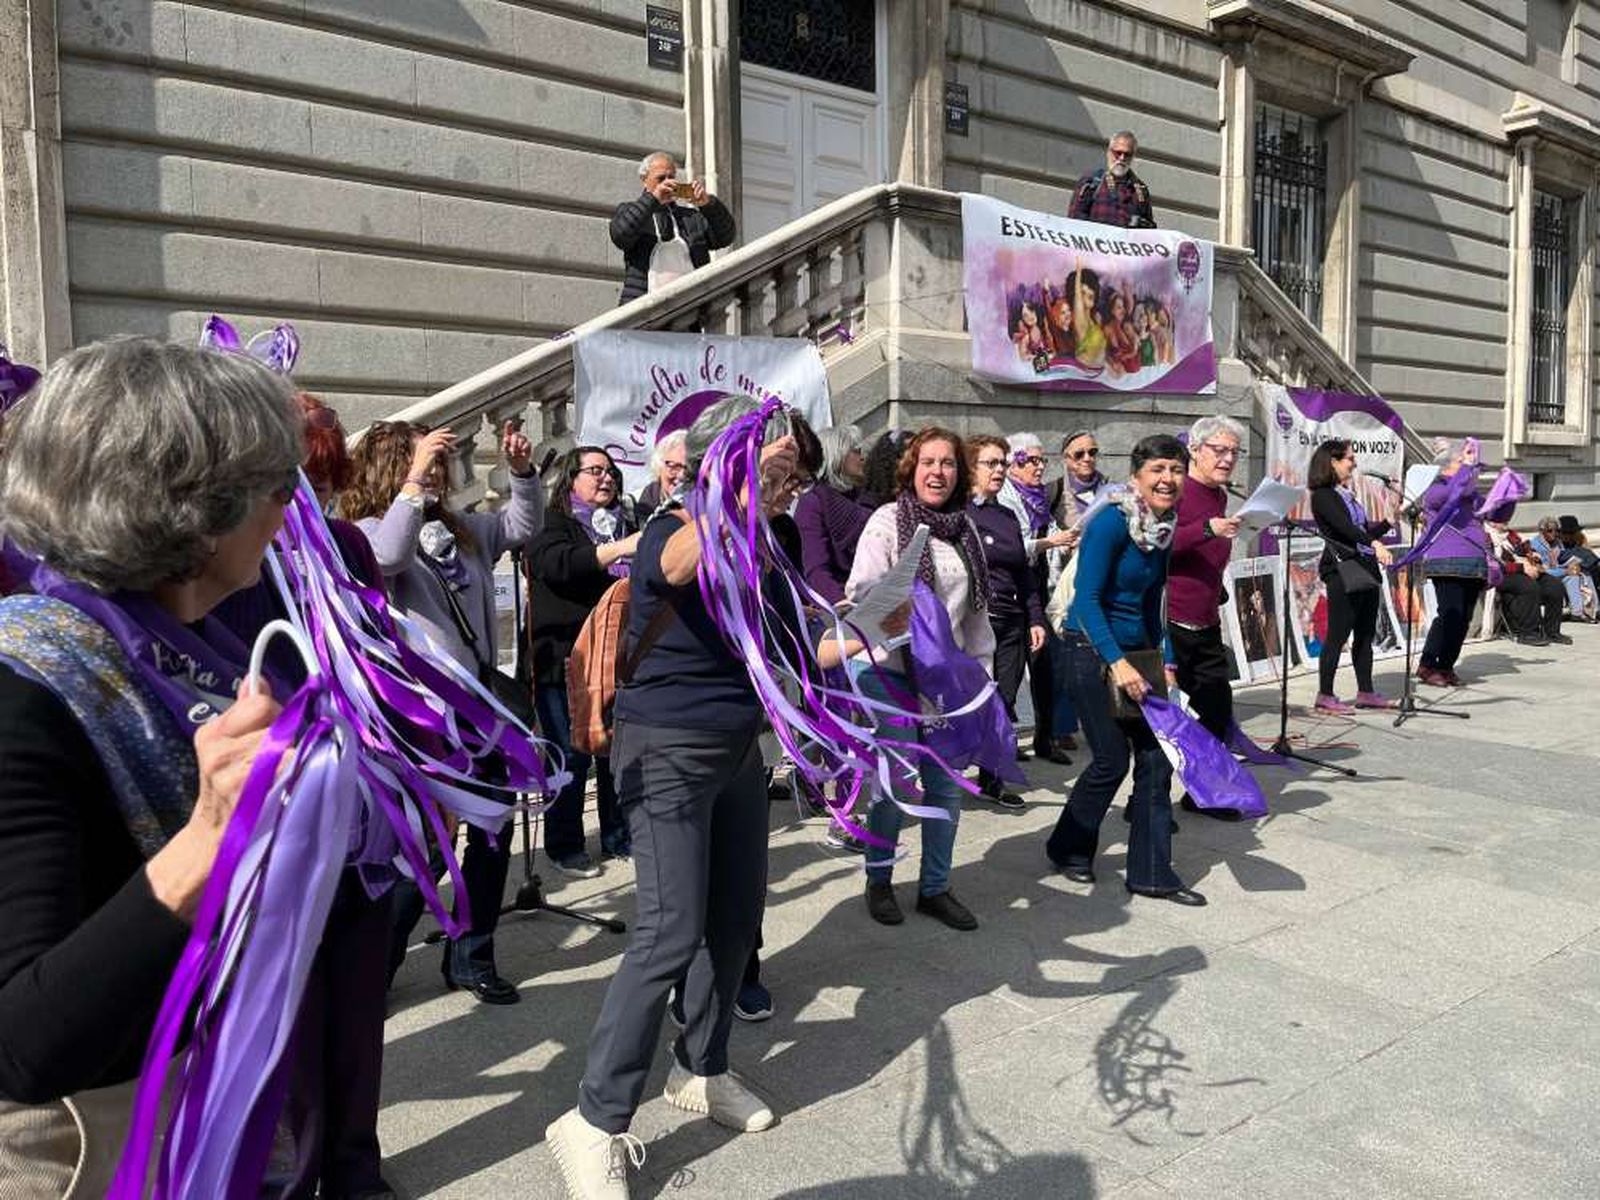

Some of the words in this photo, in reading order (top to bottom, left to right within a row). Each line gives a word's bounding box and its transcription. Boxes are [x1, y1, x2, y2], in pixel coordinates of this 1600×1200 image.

[1000, 215, 1048, 242] ESTE
[1047, 230, 1070, 248] ES
[1070, 234, 1093, 252] MI
[1094, 238, 1170, 257] CUERPO
[604, 363, 687, 466] Revuelta
[700, 345, 728, 384] de
[1351, 440, 1367, 453] ON
